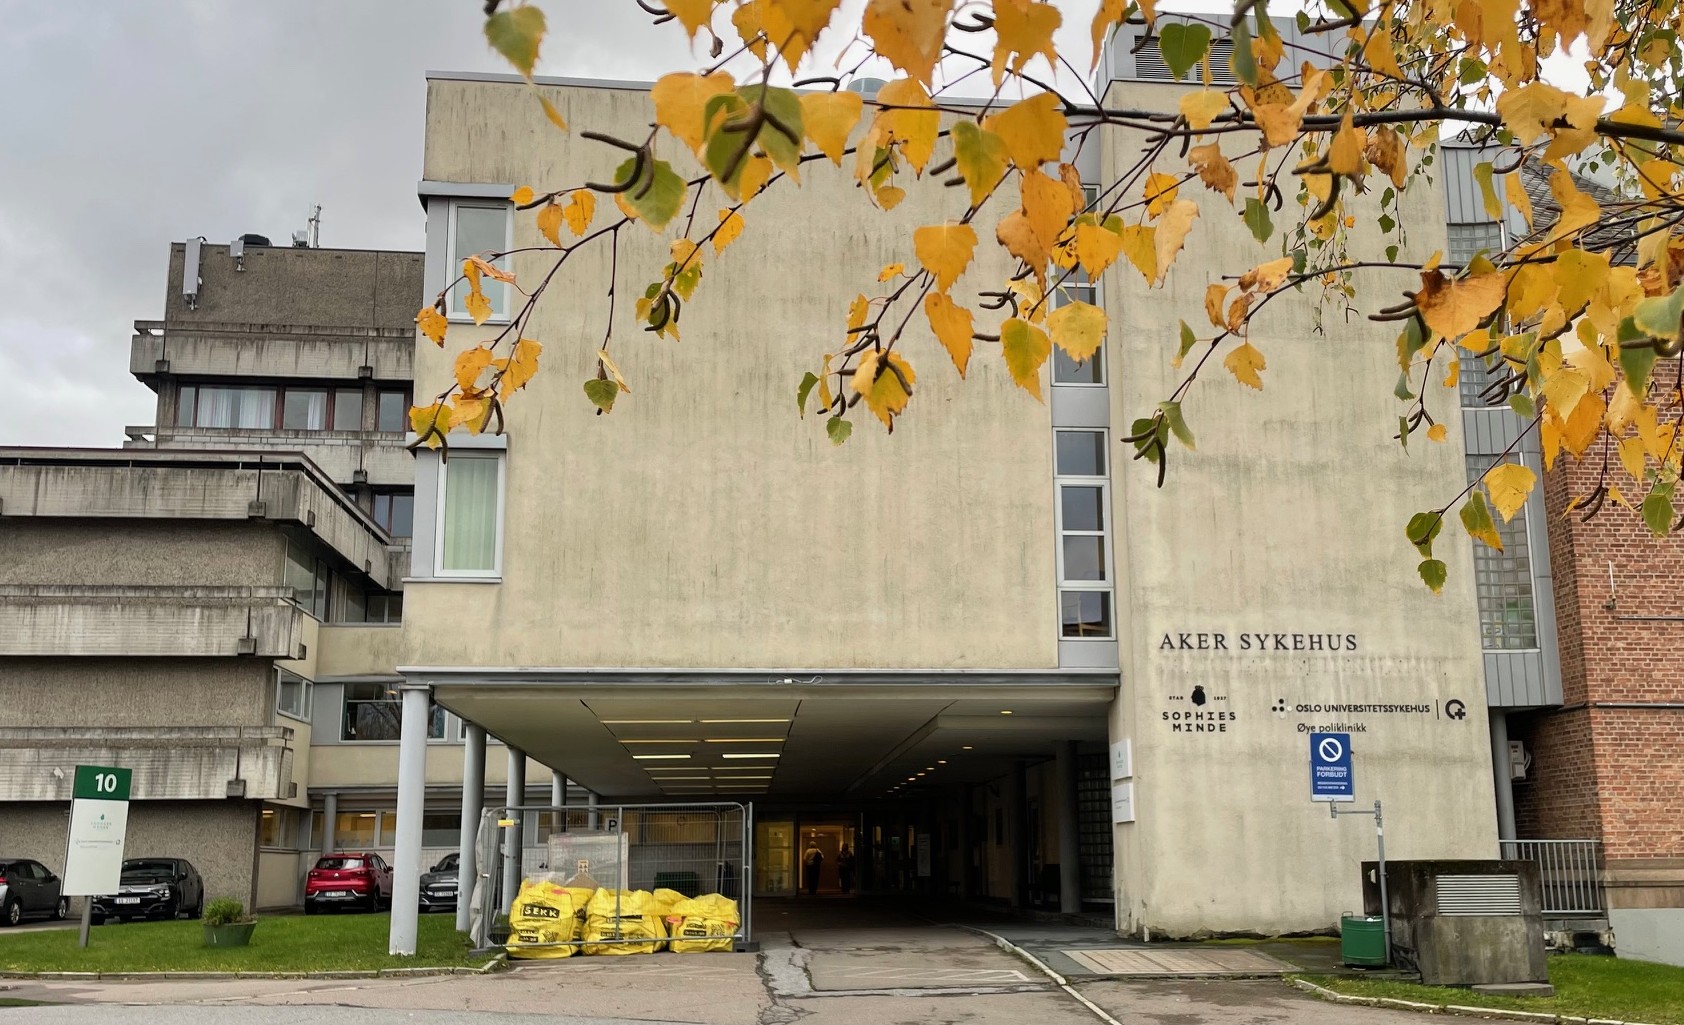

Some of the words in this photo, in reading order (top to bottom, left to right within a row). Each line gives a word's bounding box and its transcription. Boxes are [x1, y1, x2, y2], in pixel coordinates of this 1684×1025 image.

[1160, 633, 1228, 650] AKER
[1240, 634, 1357, 651] SYKEHUS
[1296, 704, 1322, 713] OSLO
[1324, 704, 1430, 713] UNIVERSITETSSYKEHUS
[1162, 711, 1236, 721] SOPHIES
[1172, 723, 1226, 732] MINDE
[1297, 723, 1316, 734] Øye
[1319, 723, 1367, 733] poliklinikk
[95, 773, 117, 793] 10
[608, 819, 618, 831] P
